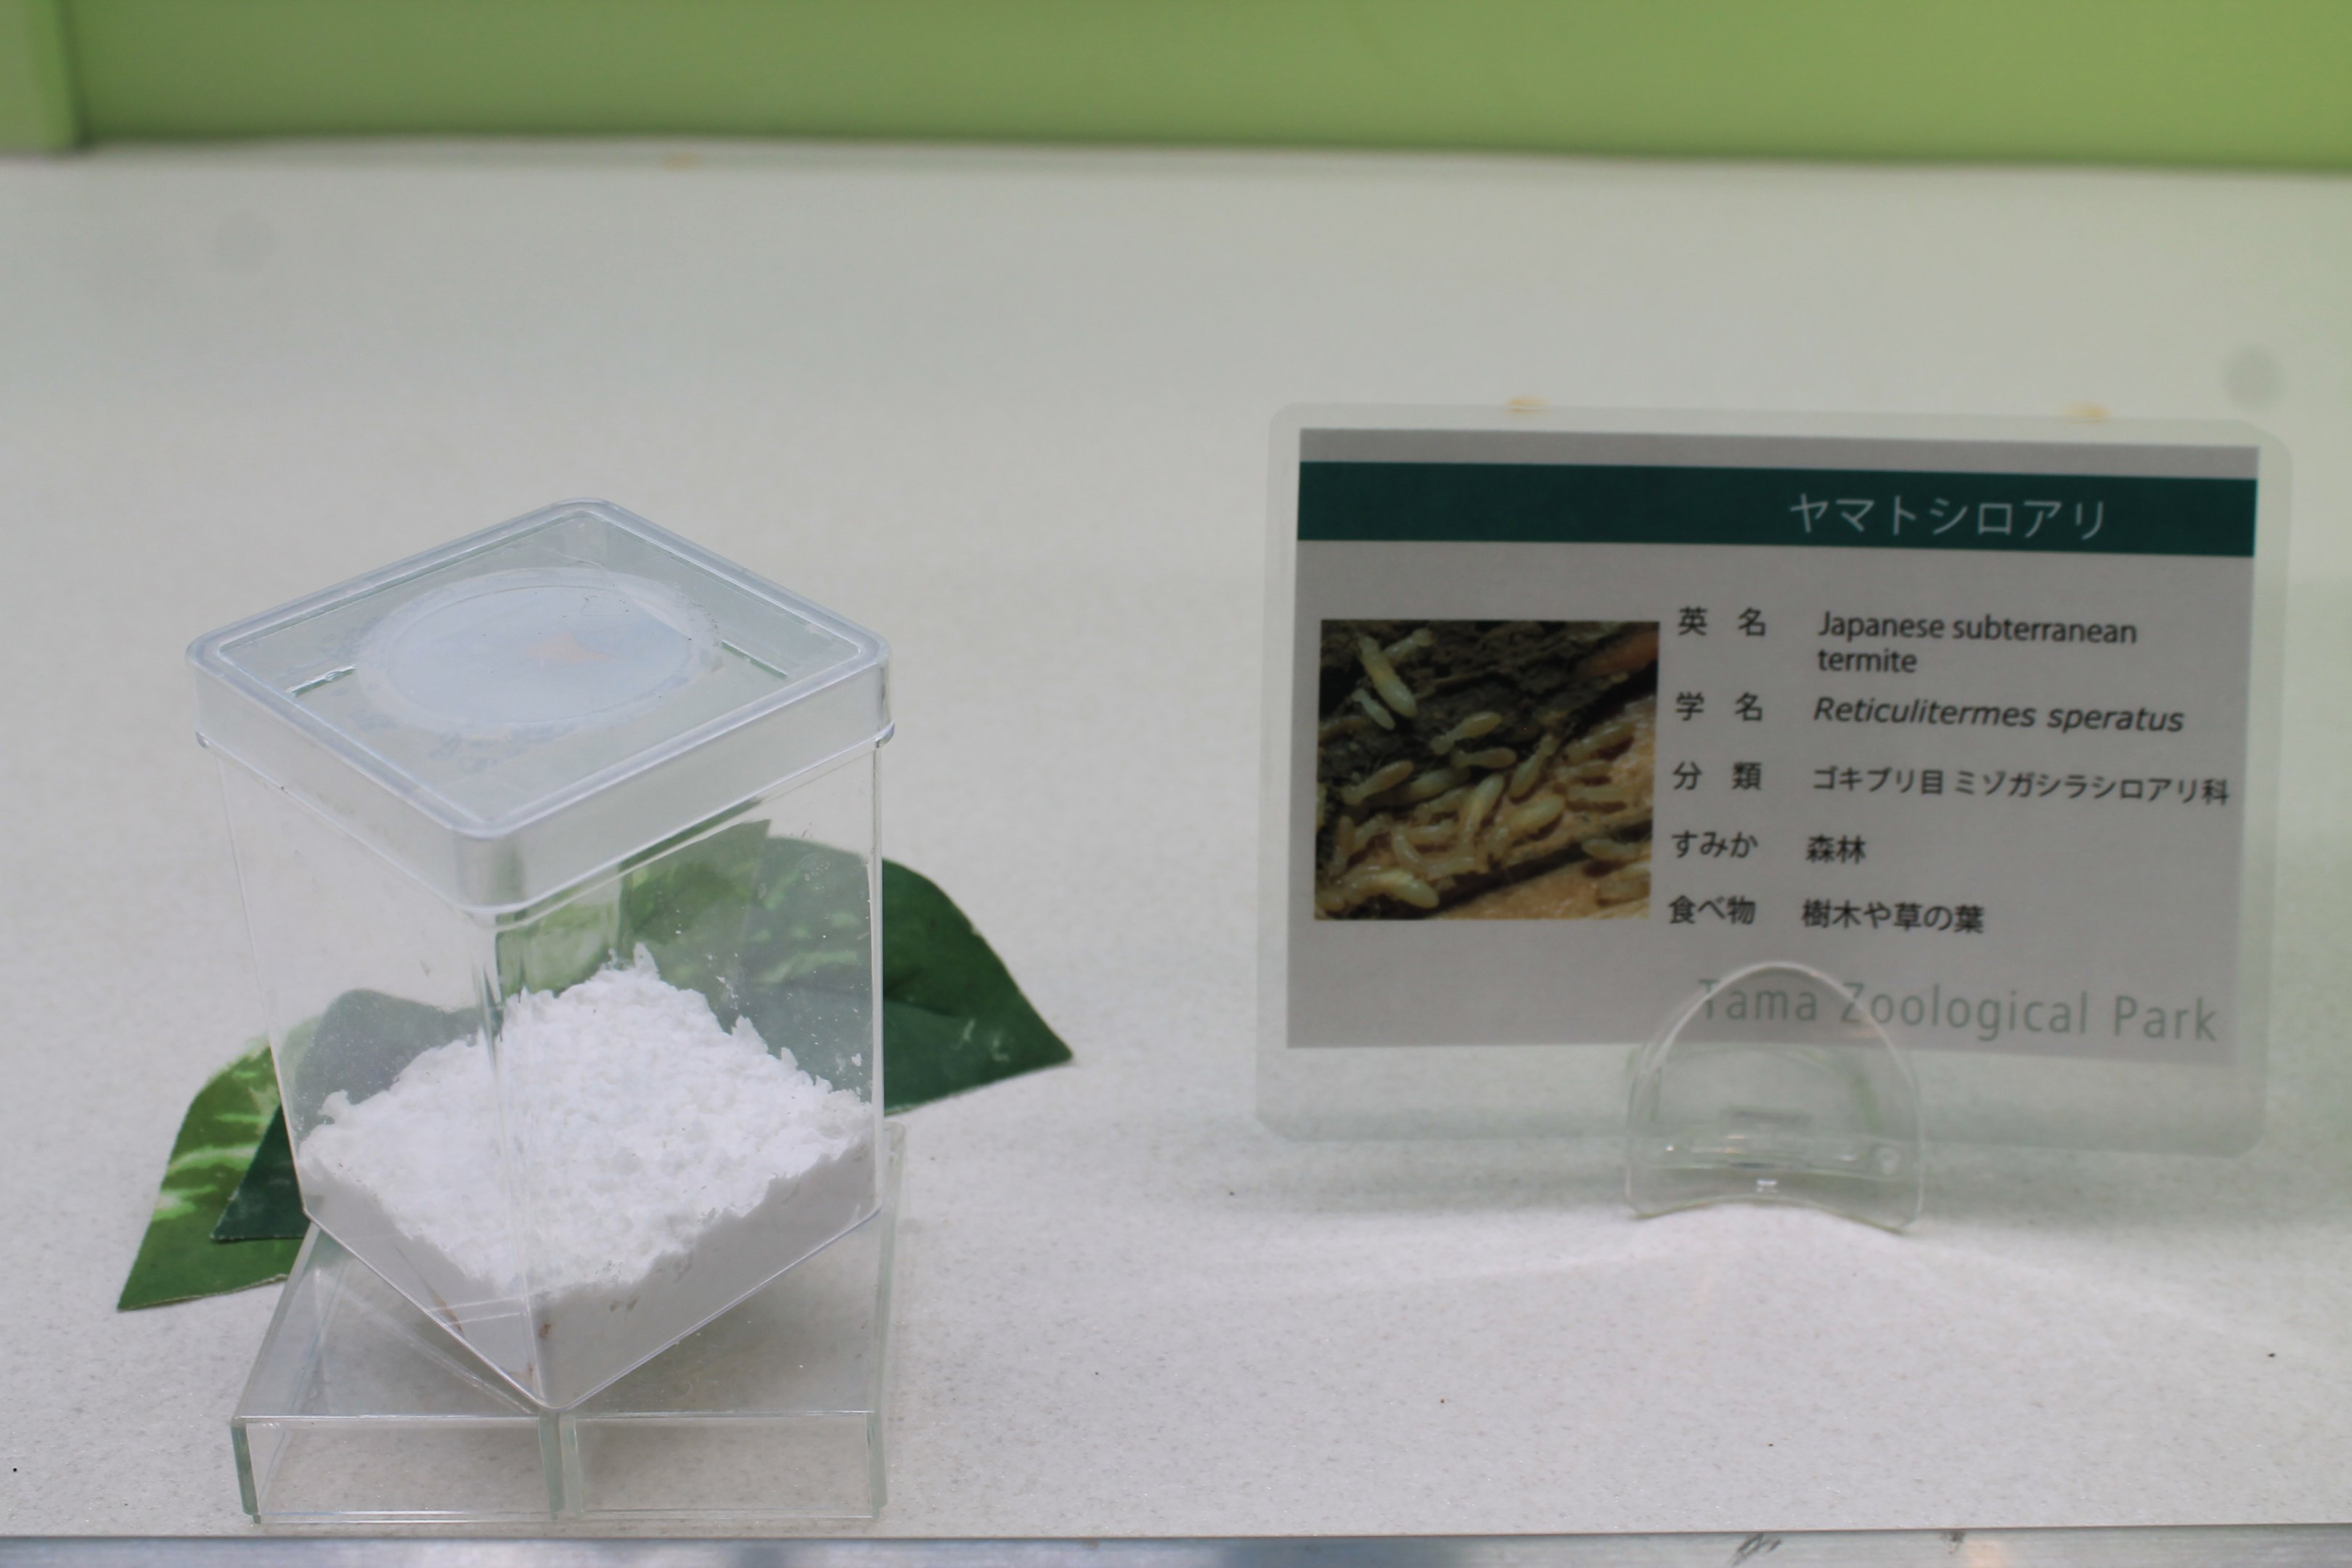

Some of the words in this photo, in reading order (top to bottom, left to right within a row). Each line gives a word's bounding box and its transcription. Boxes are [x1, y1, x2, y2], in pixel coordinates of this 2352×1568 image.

[1789, 494, 2105, 541] ヤマトシロアリ
[1818, 611, 1946, 644] Japanese
[1953, 613, 2139, 645] subterranean
[1818, 648, 1919, 674] termite
[1813, 696, 2037, 728] Reticulitermes
[2046, 708, 2186, 737] speratus
[1672, 830, 1760, 860] すみか
[1806, 834, 1868, 865] 森林
[1668, 894, 1757, 927] 食べ物
[1801, 899, 1985, 935] 樹木や草の葉
[1698, 978, 1818, 1023] Tama
[1841, 981, 2089, 1042] Zoological
[2114, 995, 2218, 1043] Park
